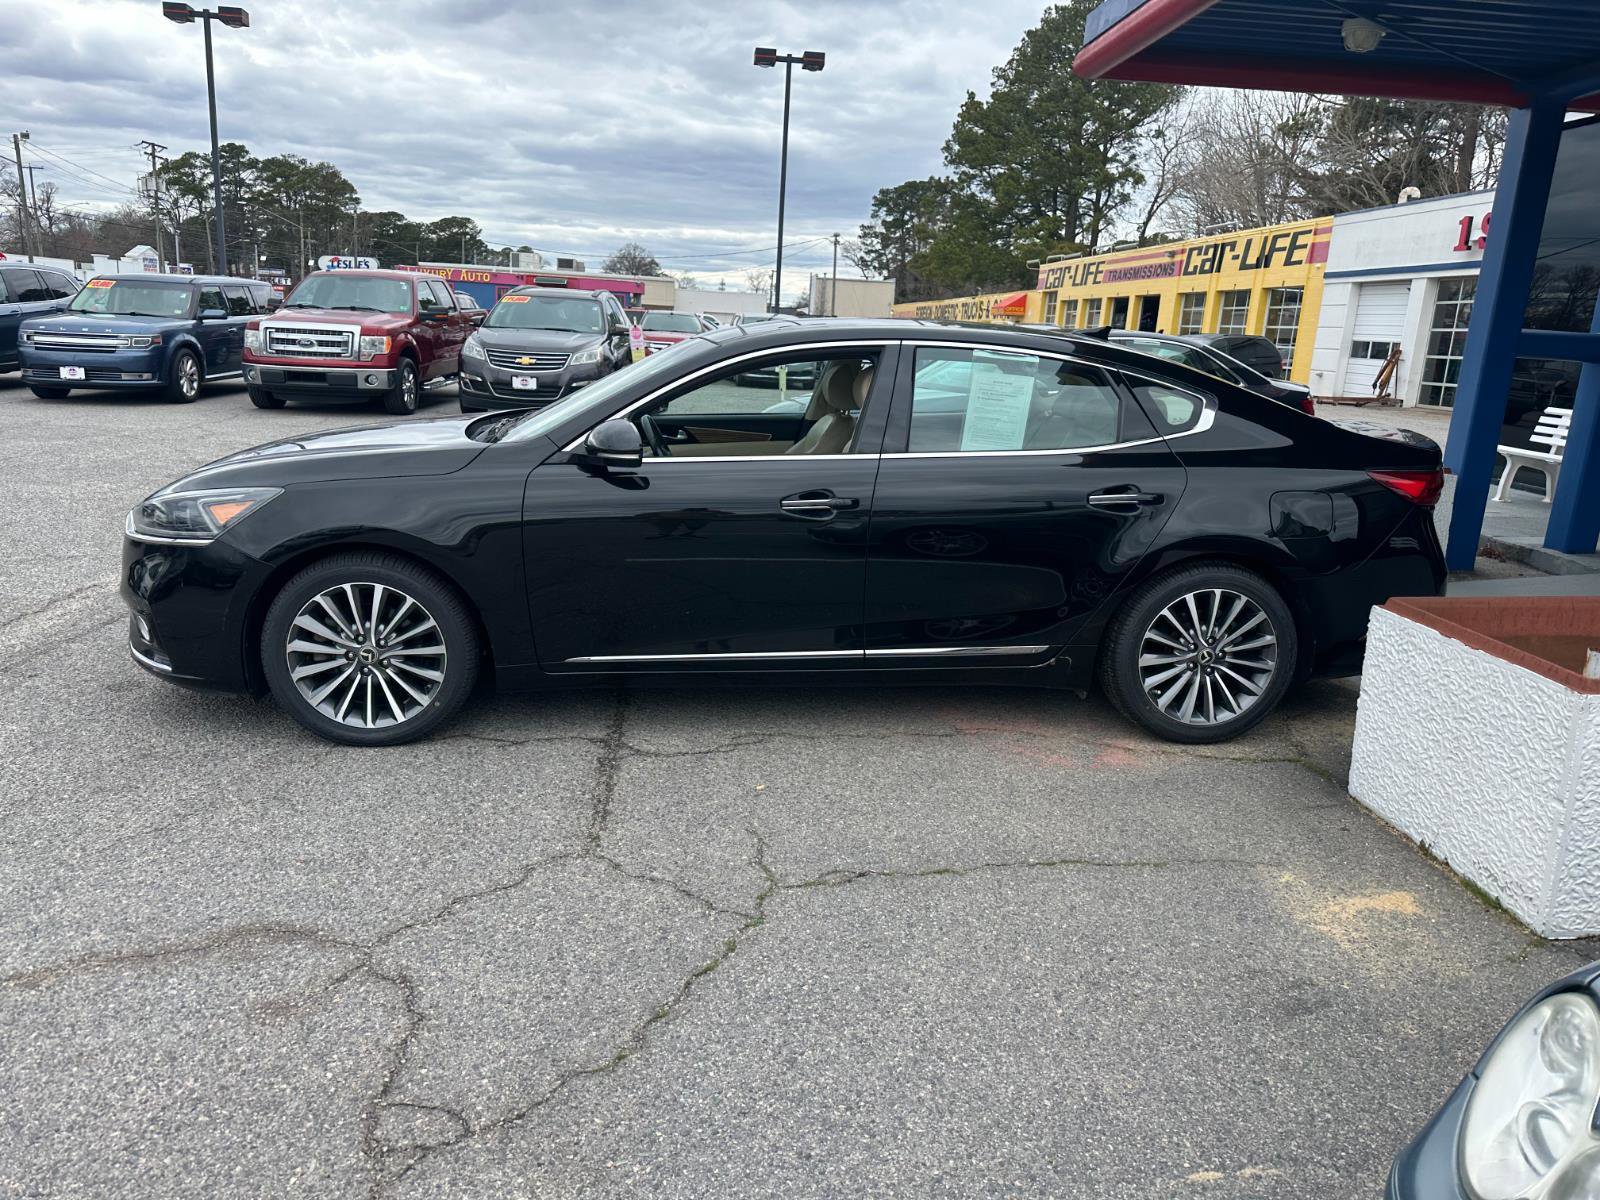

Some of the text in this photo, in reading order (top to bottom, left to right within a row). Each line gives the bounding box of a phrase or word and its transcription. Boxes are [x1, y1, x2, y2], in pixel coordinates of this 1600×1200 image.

[331, 259, 370, 269] LESLE'S
[460, 269, 490, 282] AUTO
[1108, 263, 1175, 281] TRANSMISSIONS
